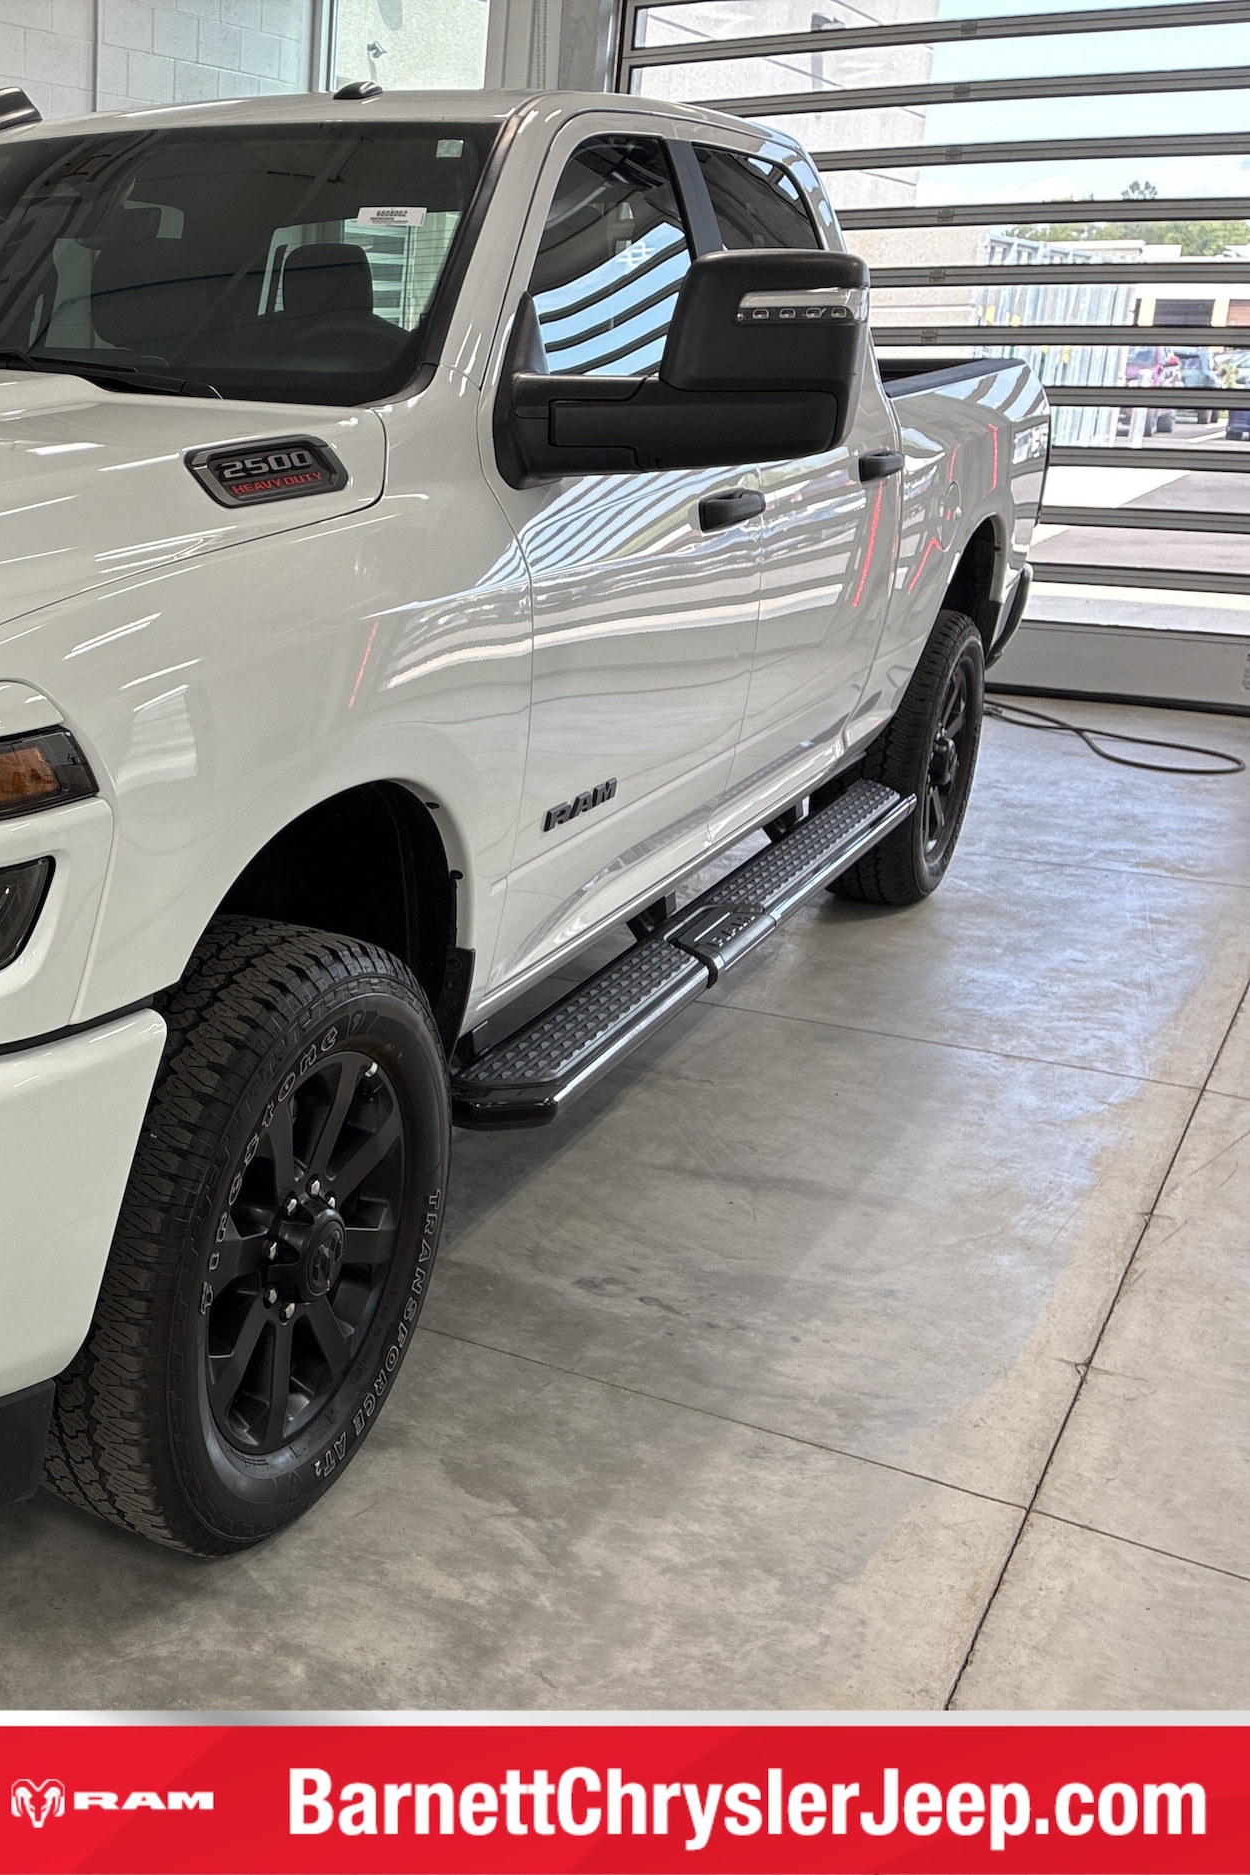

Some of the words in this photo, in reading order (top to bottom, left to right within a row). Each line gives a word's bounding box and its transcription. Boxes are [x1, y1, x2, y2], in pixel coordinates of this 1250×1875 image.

[221, 450, 313, 479] 2500
[231, 480, 282, 494] HEAVY
[285, 471, 323, 486] DUTY
[541, 777, 618, 832] RAM
[352, 1188, 442, 1437] TRANSFORCE
